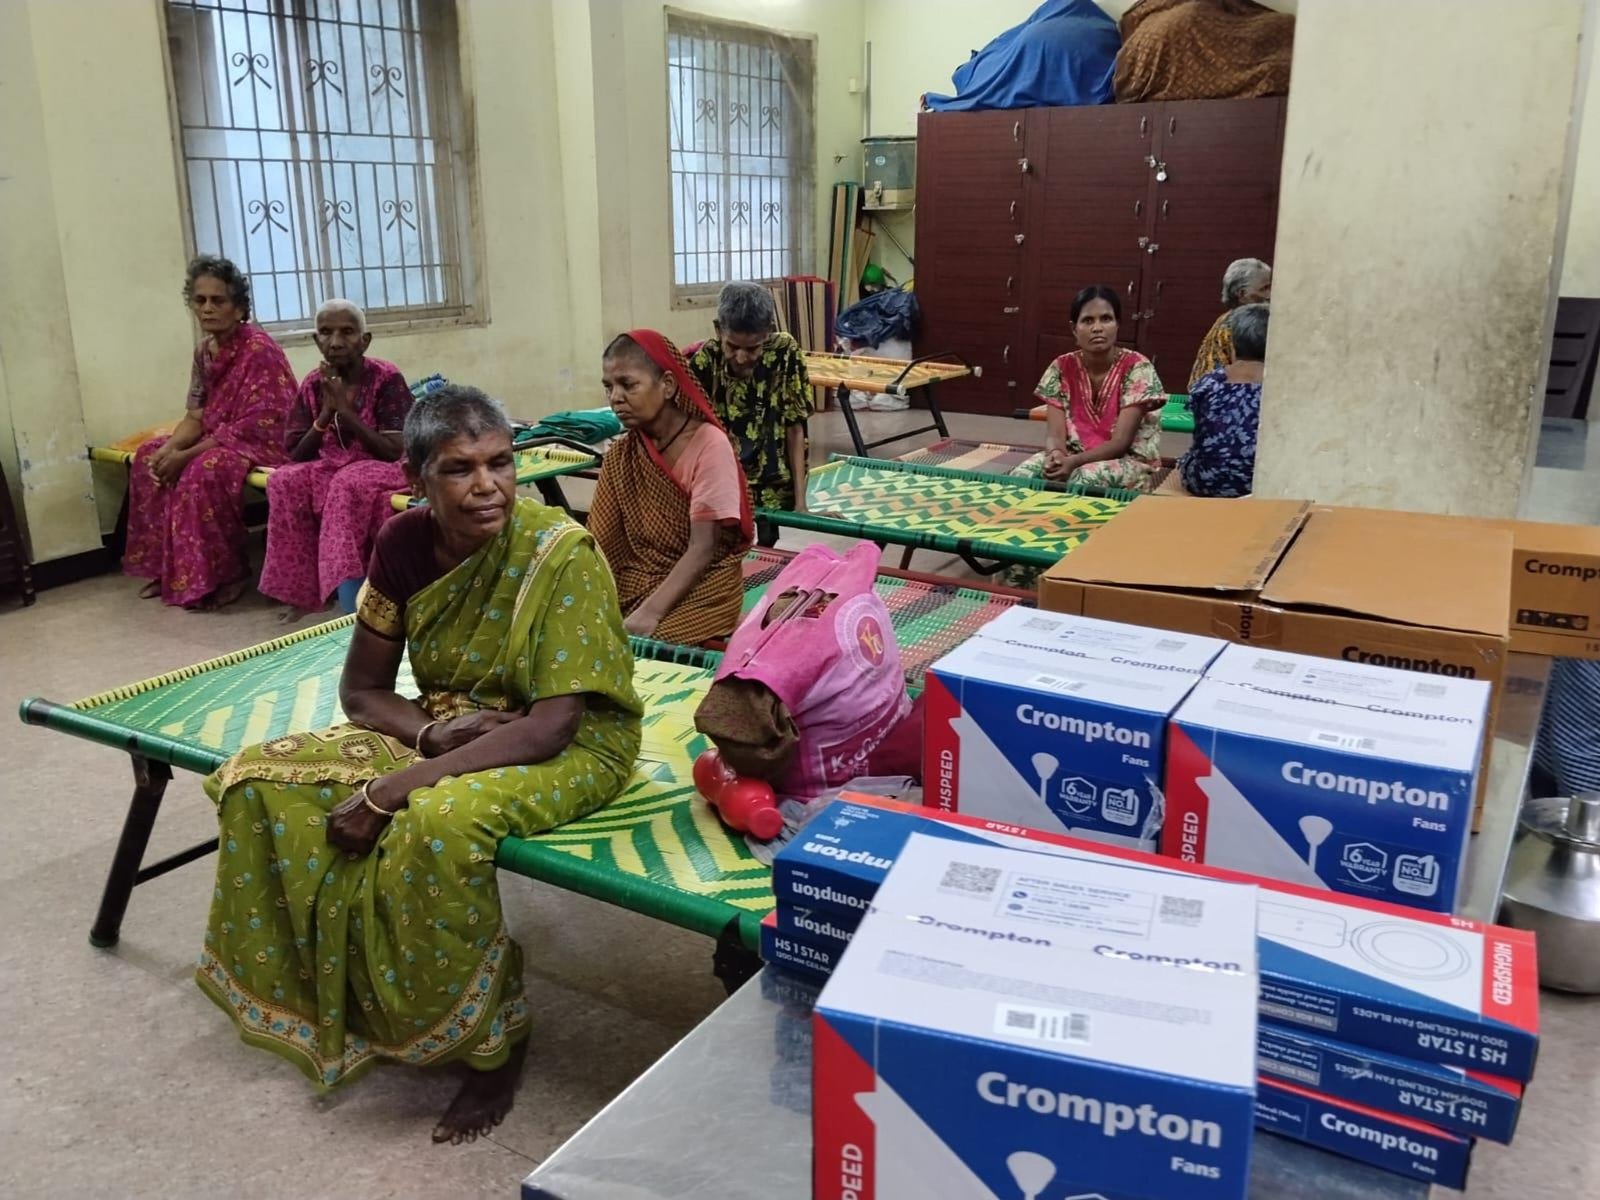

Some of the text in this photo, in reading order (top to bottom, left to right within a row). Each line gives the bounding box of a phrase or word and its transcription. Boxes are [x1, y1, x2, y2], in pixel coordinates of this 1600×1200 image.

[1525, 559, 1600, 582] Cromp
[1005, 638, 1087, 659] Crompton
[1341, 646, 1477, 680] Crompton
[1016, 703, 1151, 749] Crompton
[1366, 703, 1474, 725] Crompton
[1122, 753, 1150, 768] Fans
[1066, 782, 1078, 795] 6
[1281, 760, 1450, 811] Crompton
[1181, 811, 1199, 863] SPEED
[1412, 817, 1447, 832] Fans
[814, 833, 841, 844] Fans
[1340, 860, 1388, 876] WARRANTY
[1349, 848, 1381, 868] 6 YEAR
[1417, 854, 1435, 879] 1
[917, 914, 1053, 948] Crompton
[775, 938, 830, 964] HS 1 STAR
[1093, 943, 1242, 972] Crompton
[1492, 941, 1512, 1005] HIGHSPEED
[1352, 1006, 1509, 1048] 1200 MM CEILING FAN BLADES
[1417, 1032, 1508, 1066] HS 1 STAR
[1375, 1071, 1396, 1085] FAN
[1396, 1078, 1440, 1096] CEILING
[976, 1070, 1222, 1149] Crompton
[1398, 1091, 1488, 1126] HS 1 STAR
[1319, 1112, 1439, 1161] Crompton
[1171, 1155, 1221, 1180] Fans
[1411, 1162, 1437, 1176] Fans
